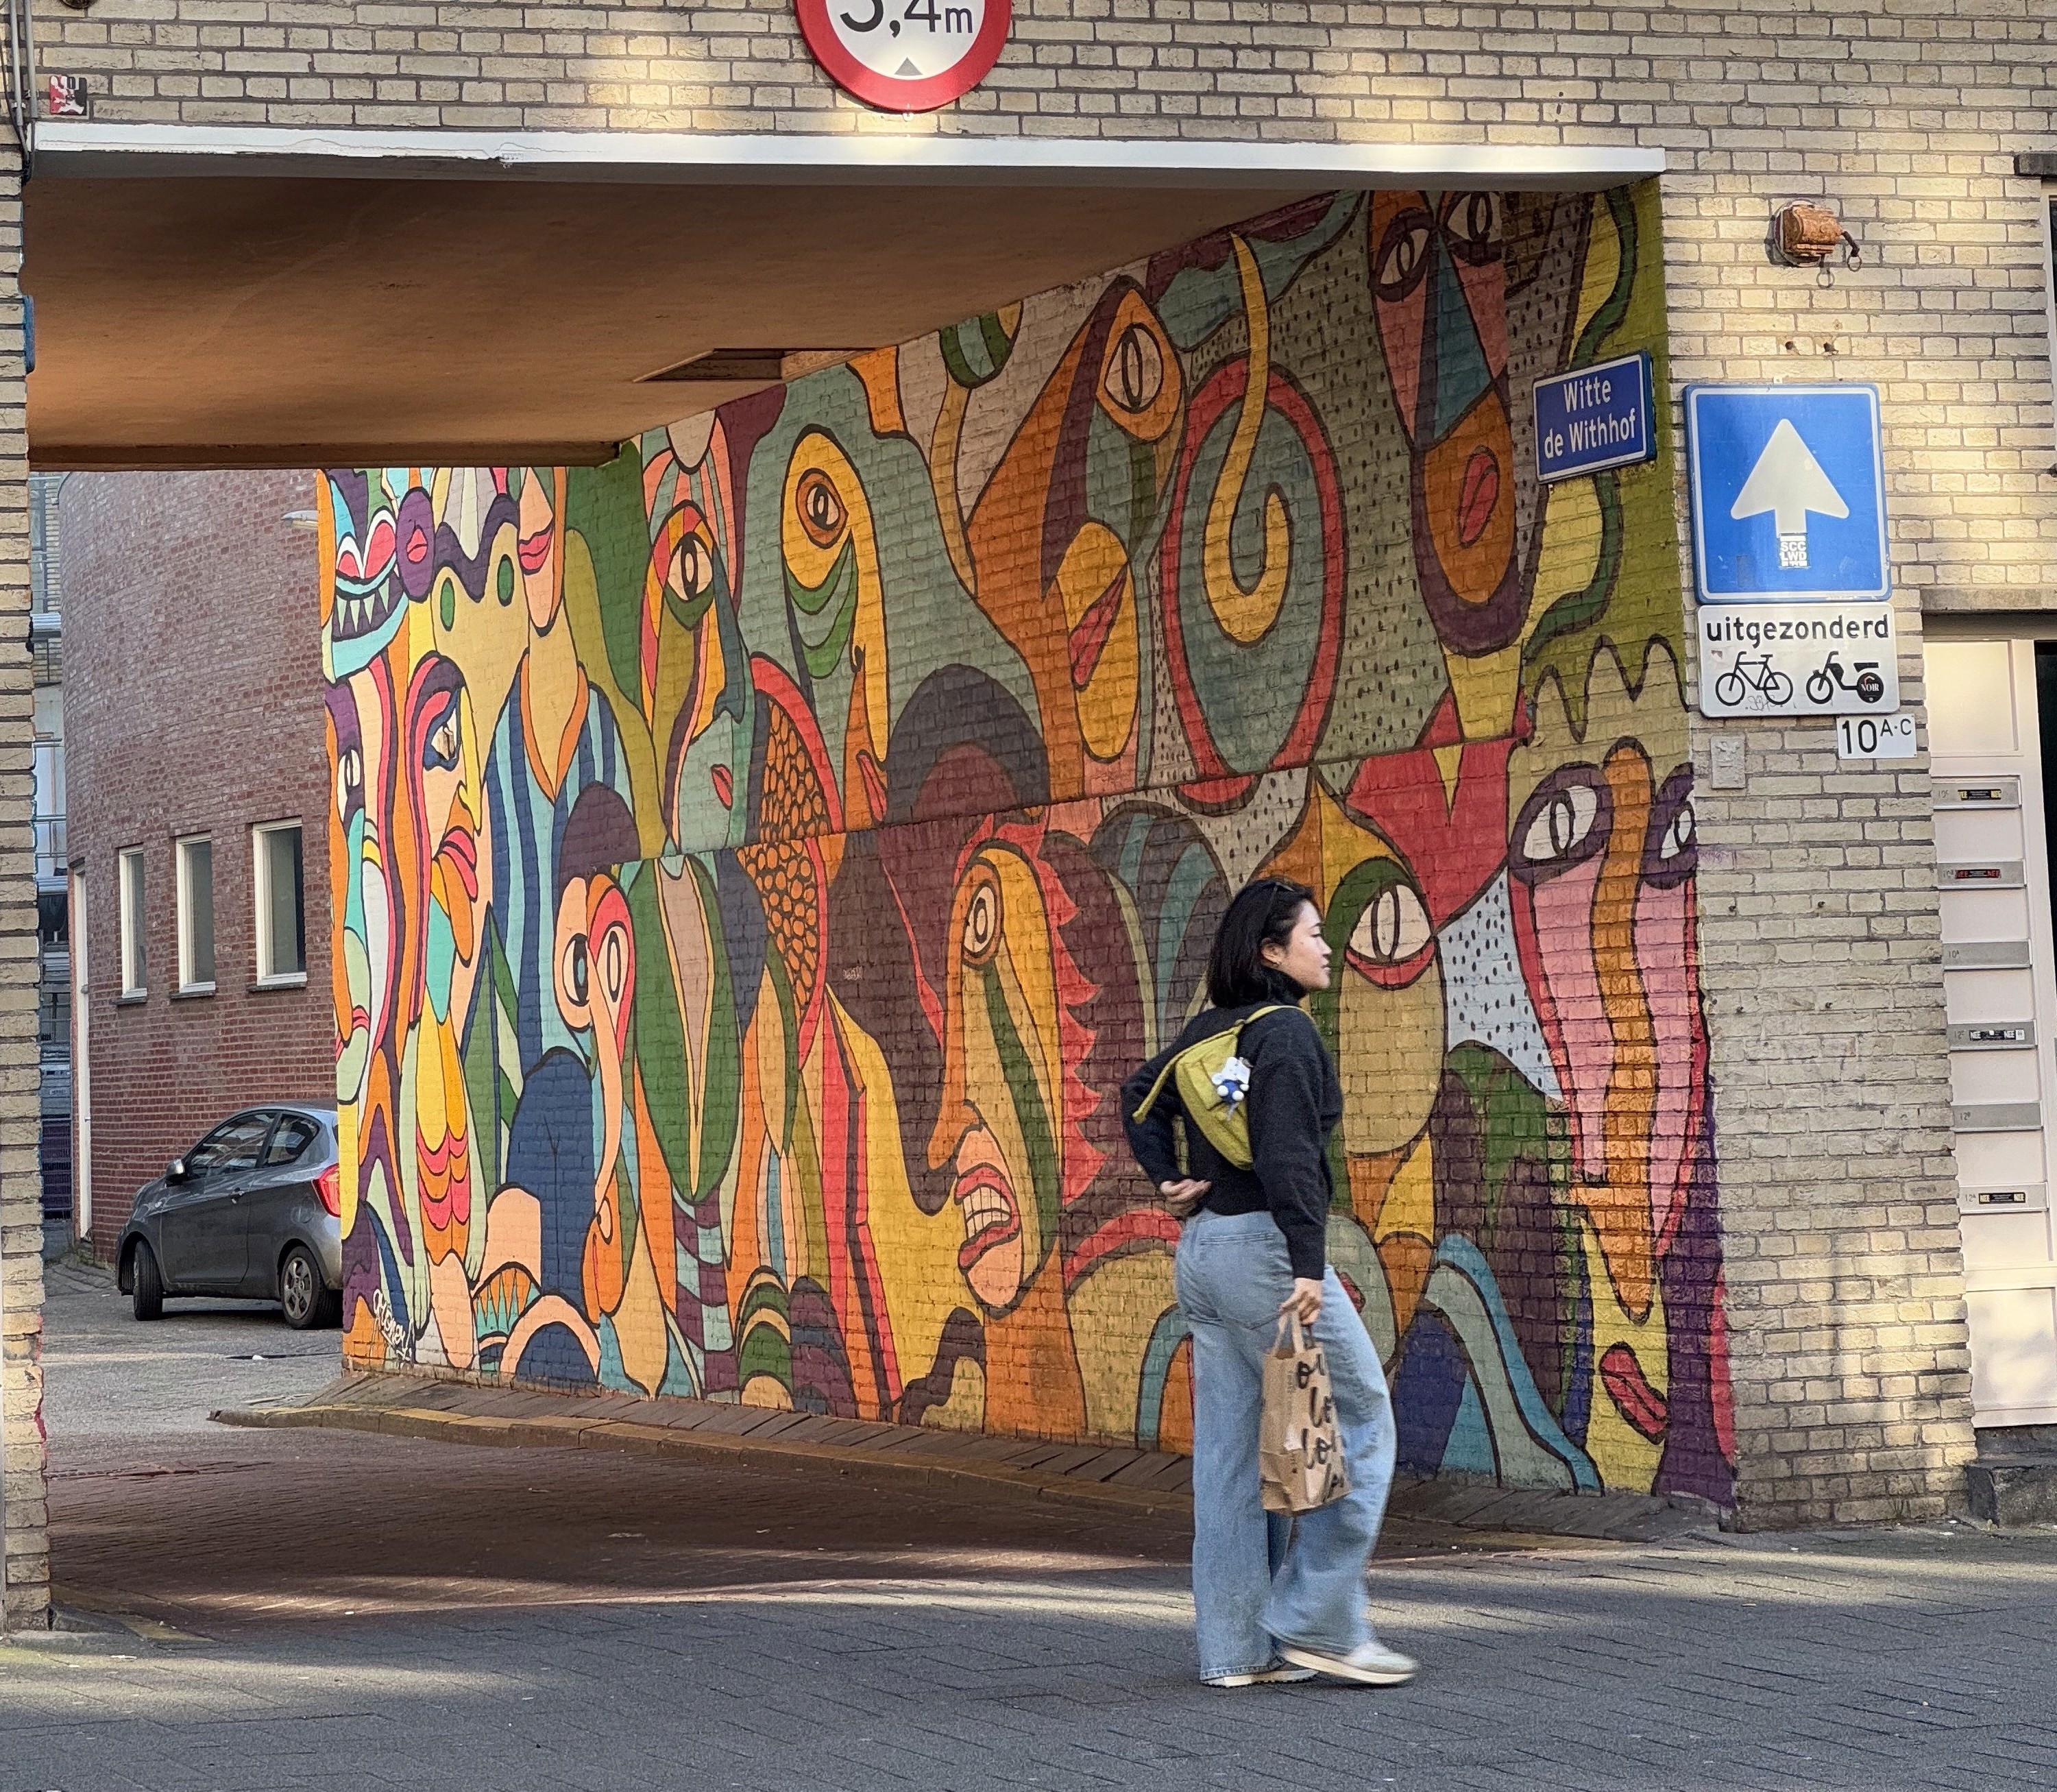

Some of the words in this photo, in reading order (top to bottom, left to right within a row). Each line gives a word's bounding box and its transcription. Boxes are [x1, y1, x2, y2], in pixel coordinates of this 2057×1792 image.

[1563, 375, 1611, 413] Witte
[1544, 428, 1564, 459] de
[1568, 407, 1636, 453] Withhof
[1780, 541, 1807, 552] SCC
[1780, 551, 1807, 561] LWD
[1706, 614, 1889, 649] uitgezonderd
[1860, 683, 1879, 692] NOIR
